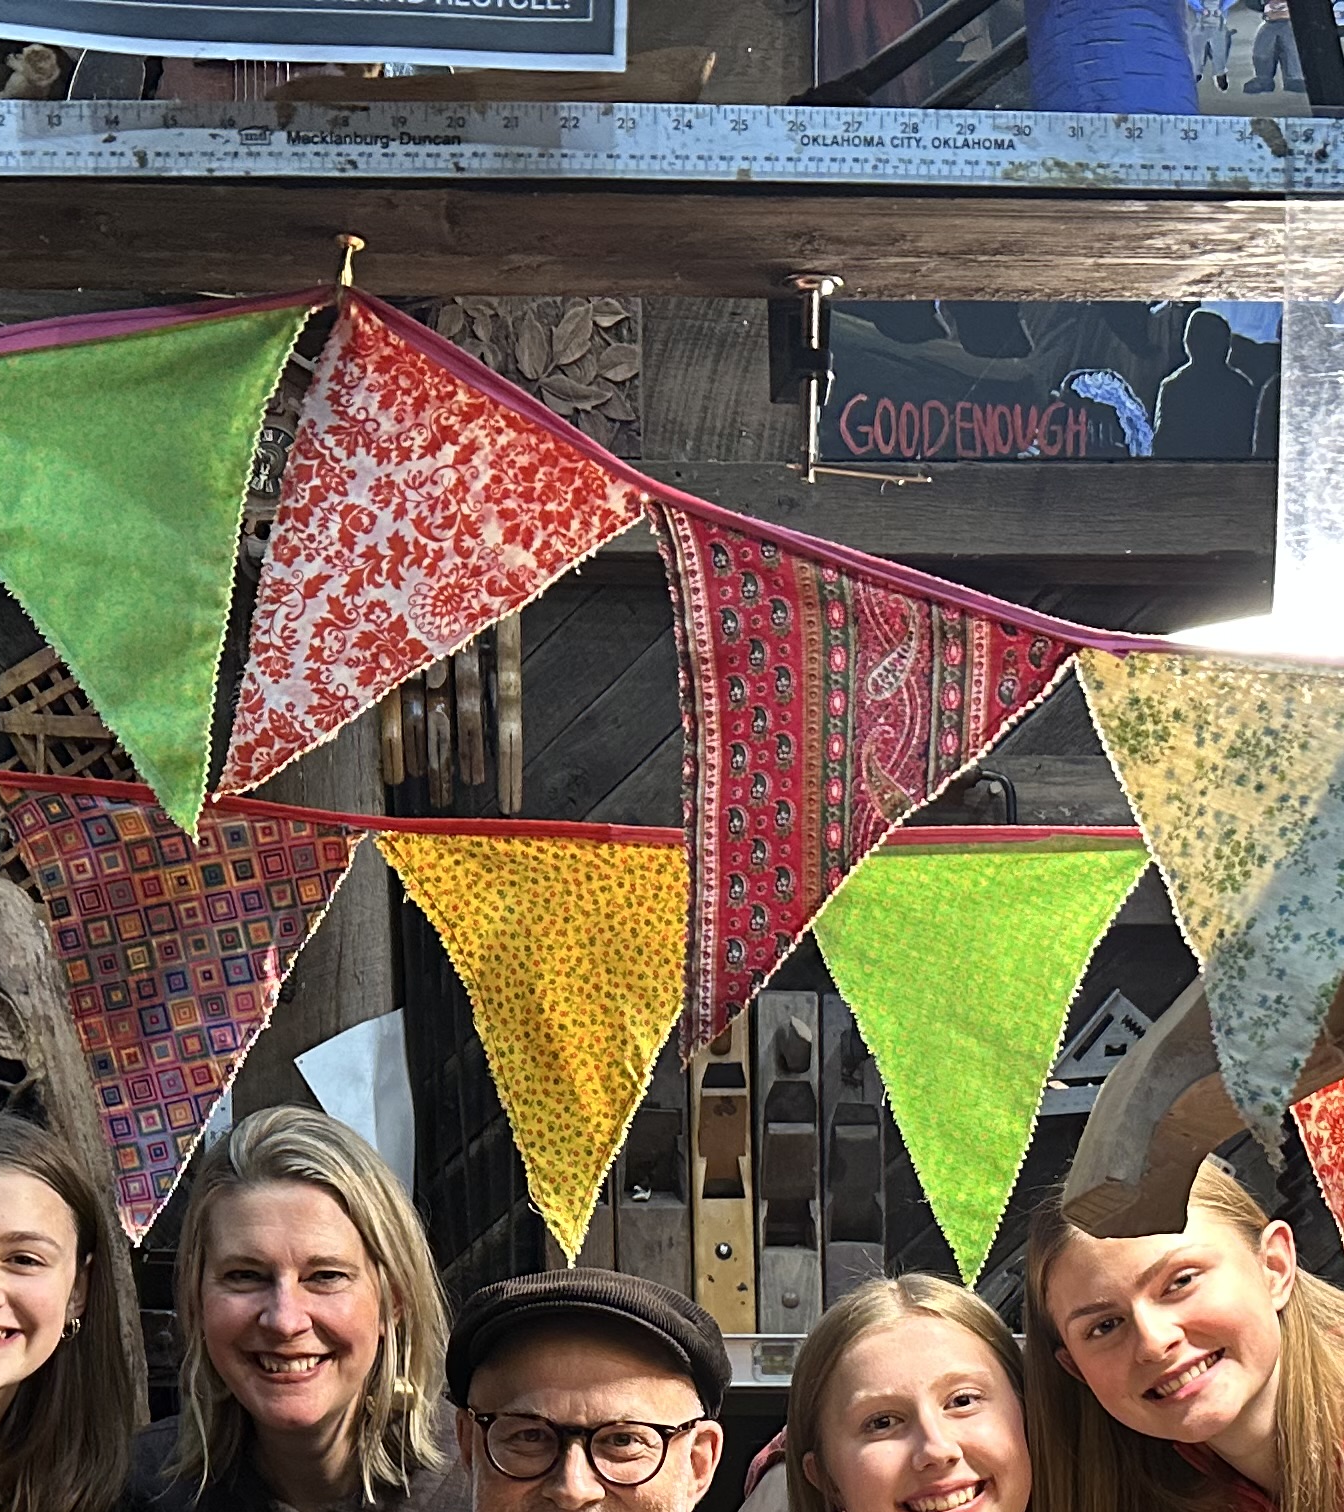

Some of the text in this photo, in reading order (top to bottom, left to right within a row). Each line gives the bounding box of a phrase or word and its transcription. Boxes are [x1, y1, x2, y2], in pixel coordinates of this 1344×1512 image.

[286, 130, 462, 149] Macklanburg-Duncan
[800, 134, 1016, 151] OKLAHOMA CITY, OKLAHOMA
[839, 393, 950, 457] GOOD
[956, 400, 1089, 458] ENOUGH
